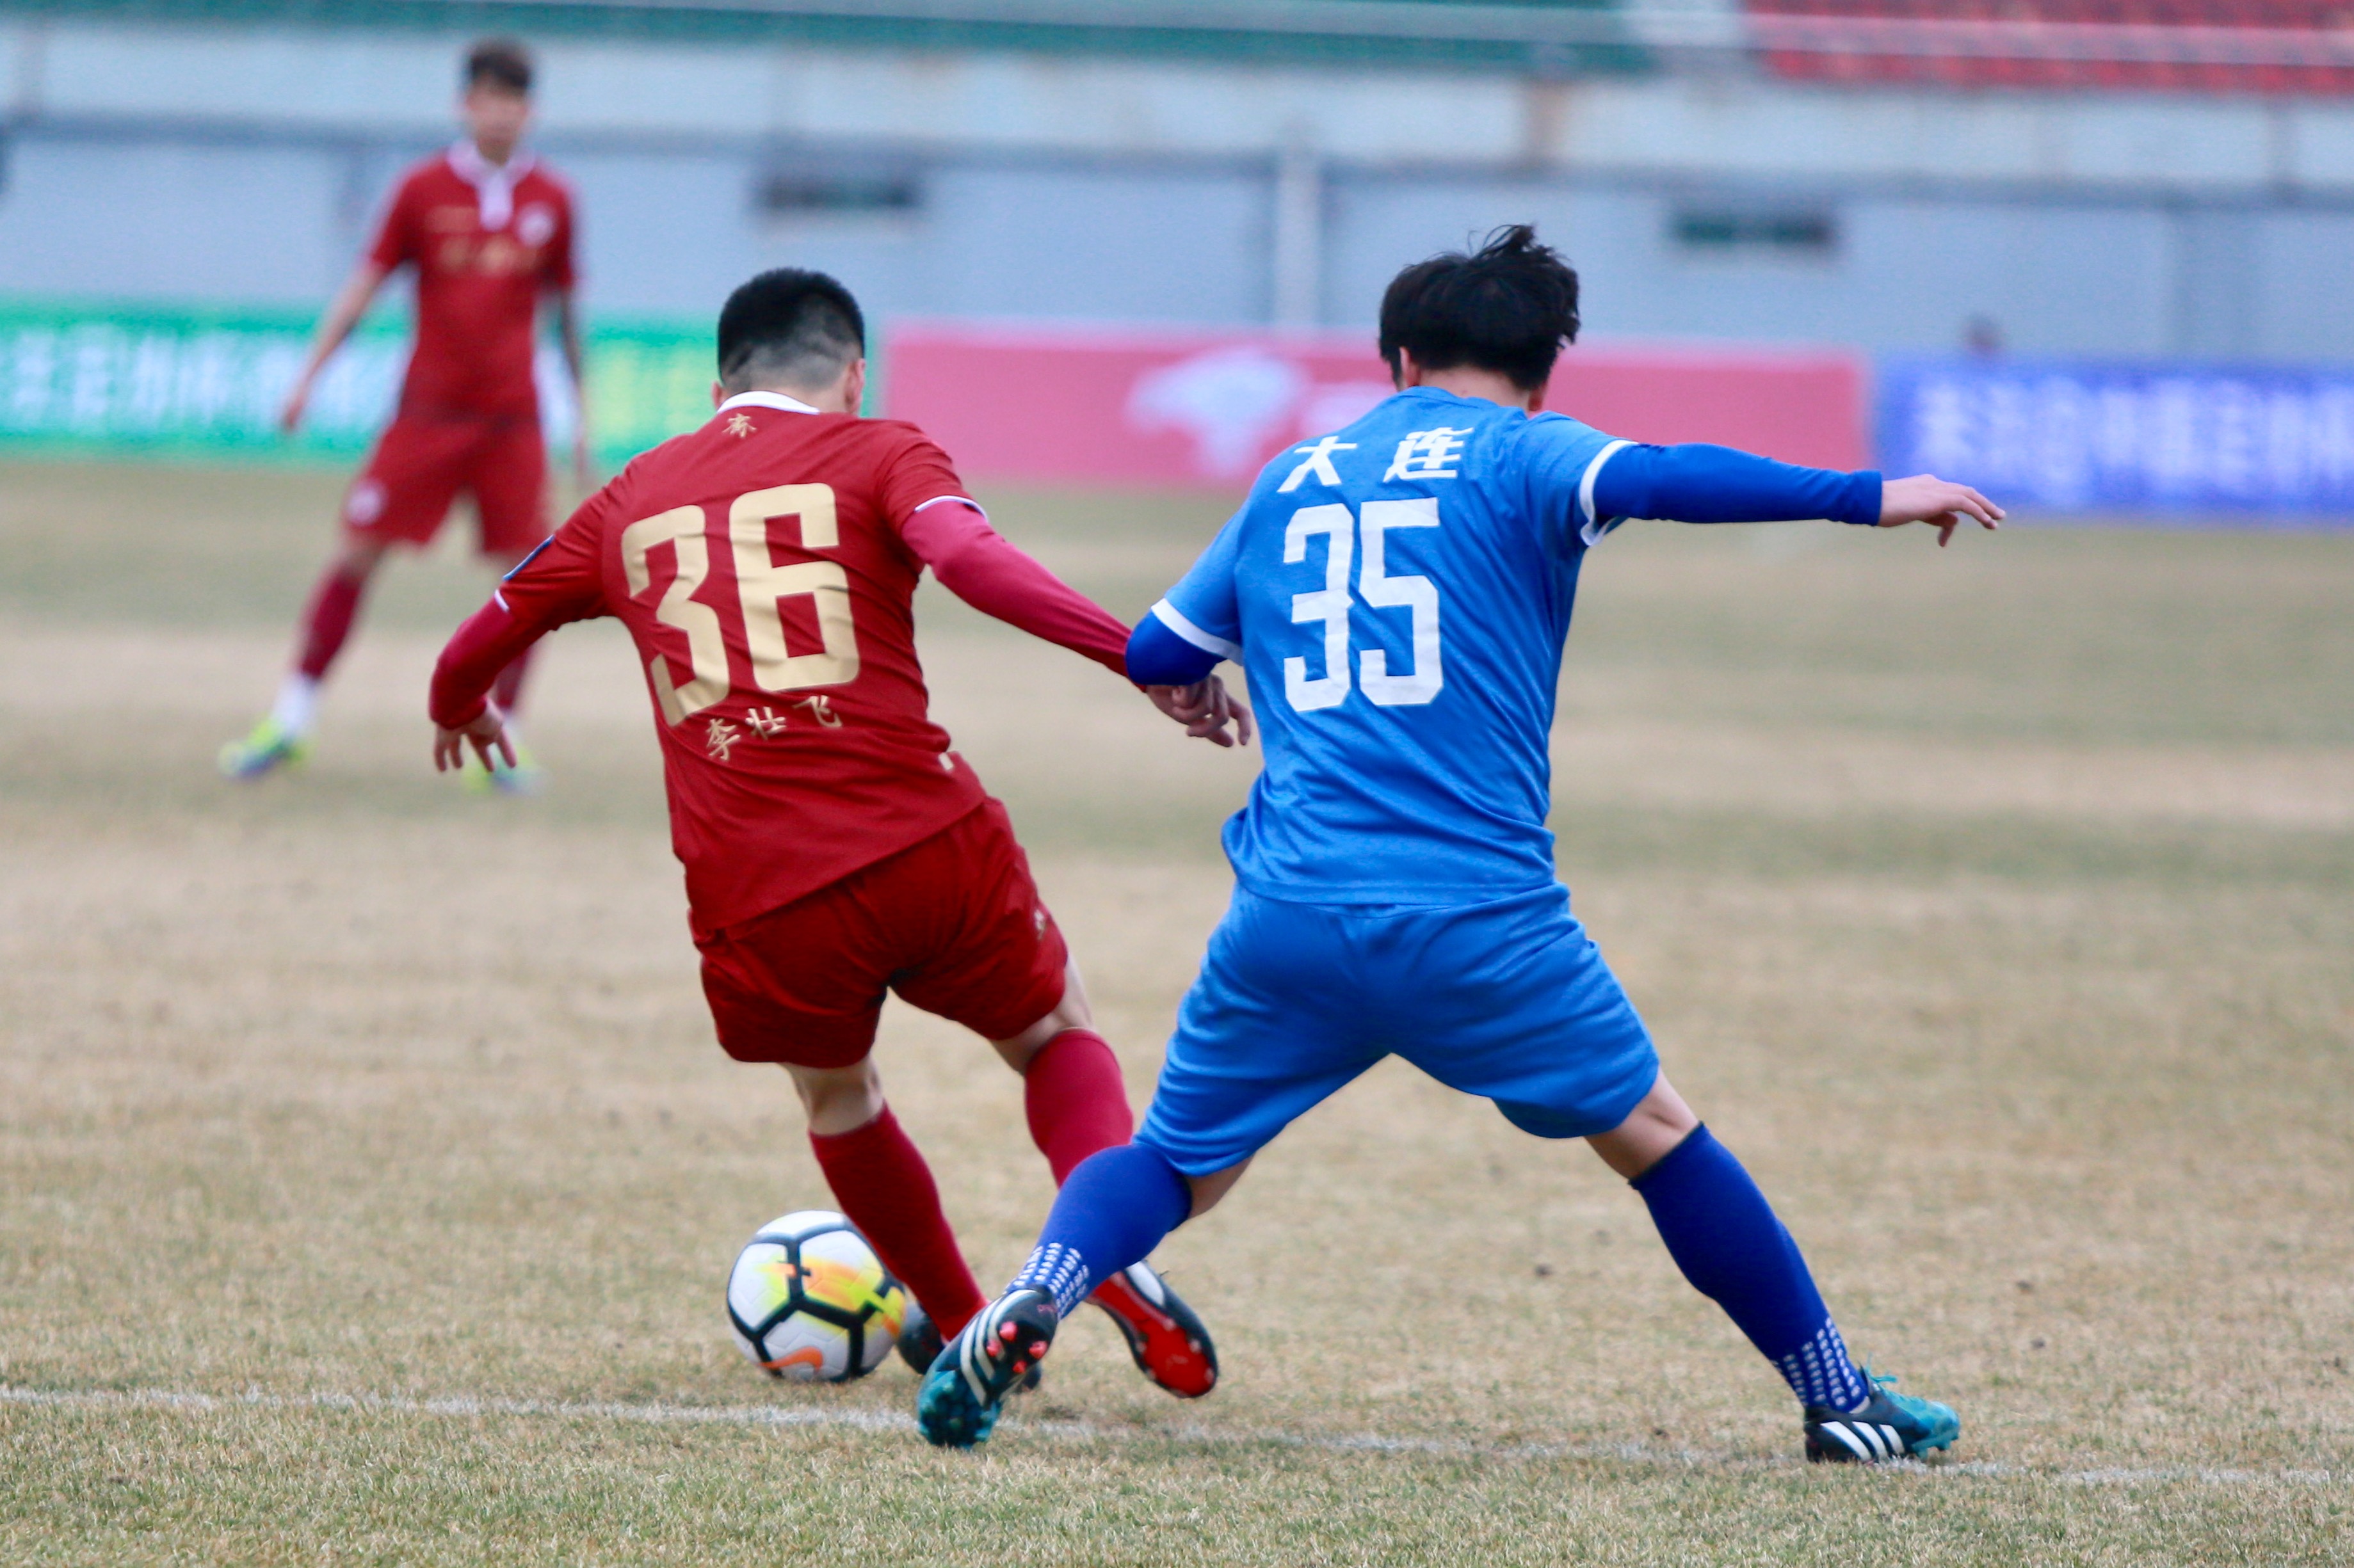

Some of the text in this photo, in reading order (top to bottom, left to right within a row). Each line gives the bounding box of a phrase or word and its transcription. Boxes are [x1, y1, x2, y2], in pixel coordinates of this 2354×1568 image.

[1277, 427, 1474, 493] 大连
[622, 483, 860, 727] 36
[1283, 497, 1444, 712] 35
[705, 695, 843, 761] 李壮飞
